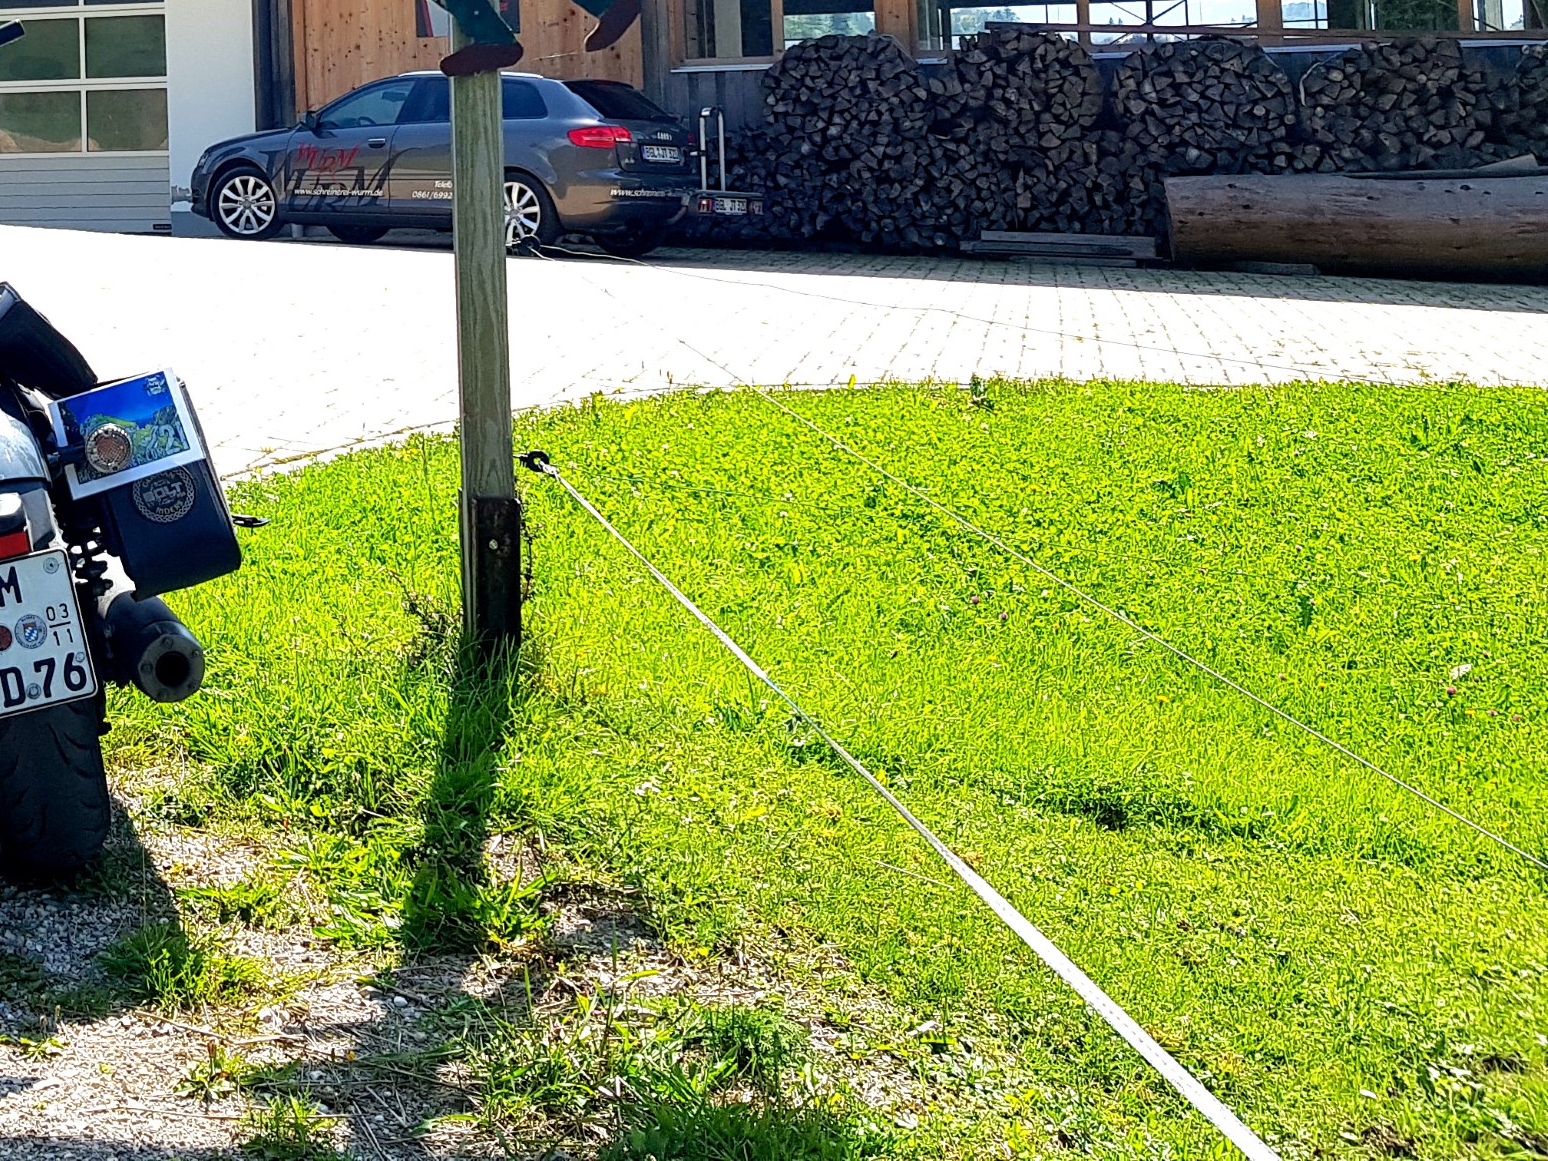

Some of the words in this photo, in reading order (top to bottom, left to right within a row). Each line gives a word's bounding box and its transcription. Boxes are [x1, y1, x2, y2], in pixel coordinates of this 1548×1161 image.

[411, 190, 453, 200] 0861/6992
[142, 482, 184, 503] BOLT
[155, 500, 184, 515] RIDERS
[45, 603, 69, 621] 03
[53, 628, 73, 646] 11
[33, 652, 88, 699] 76
